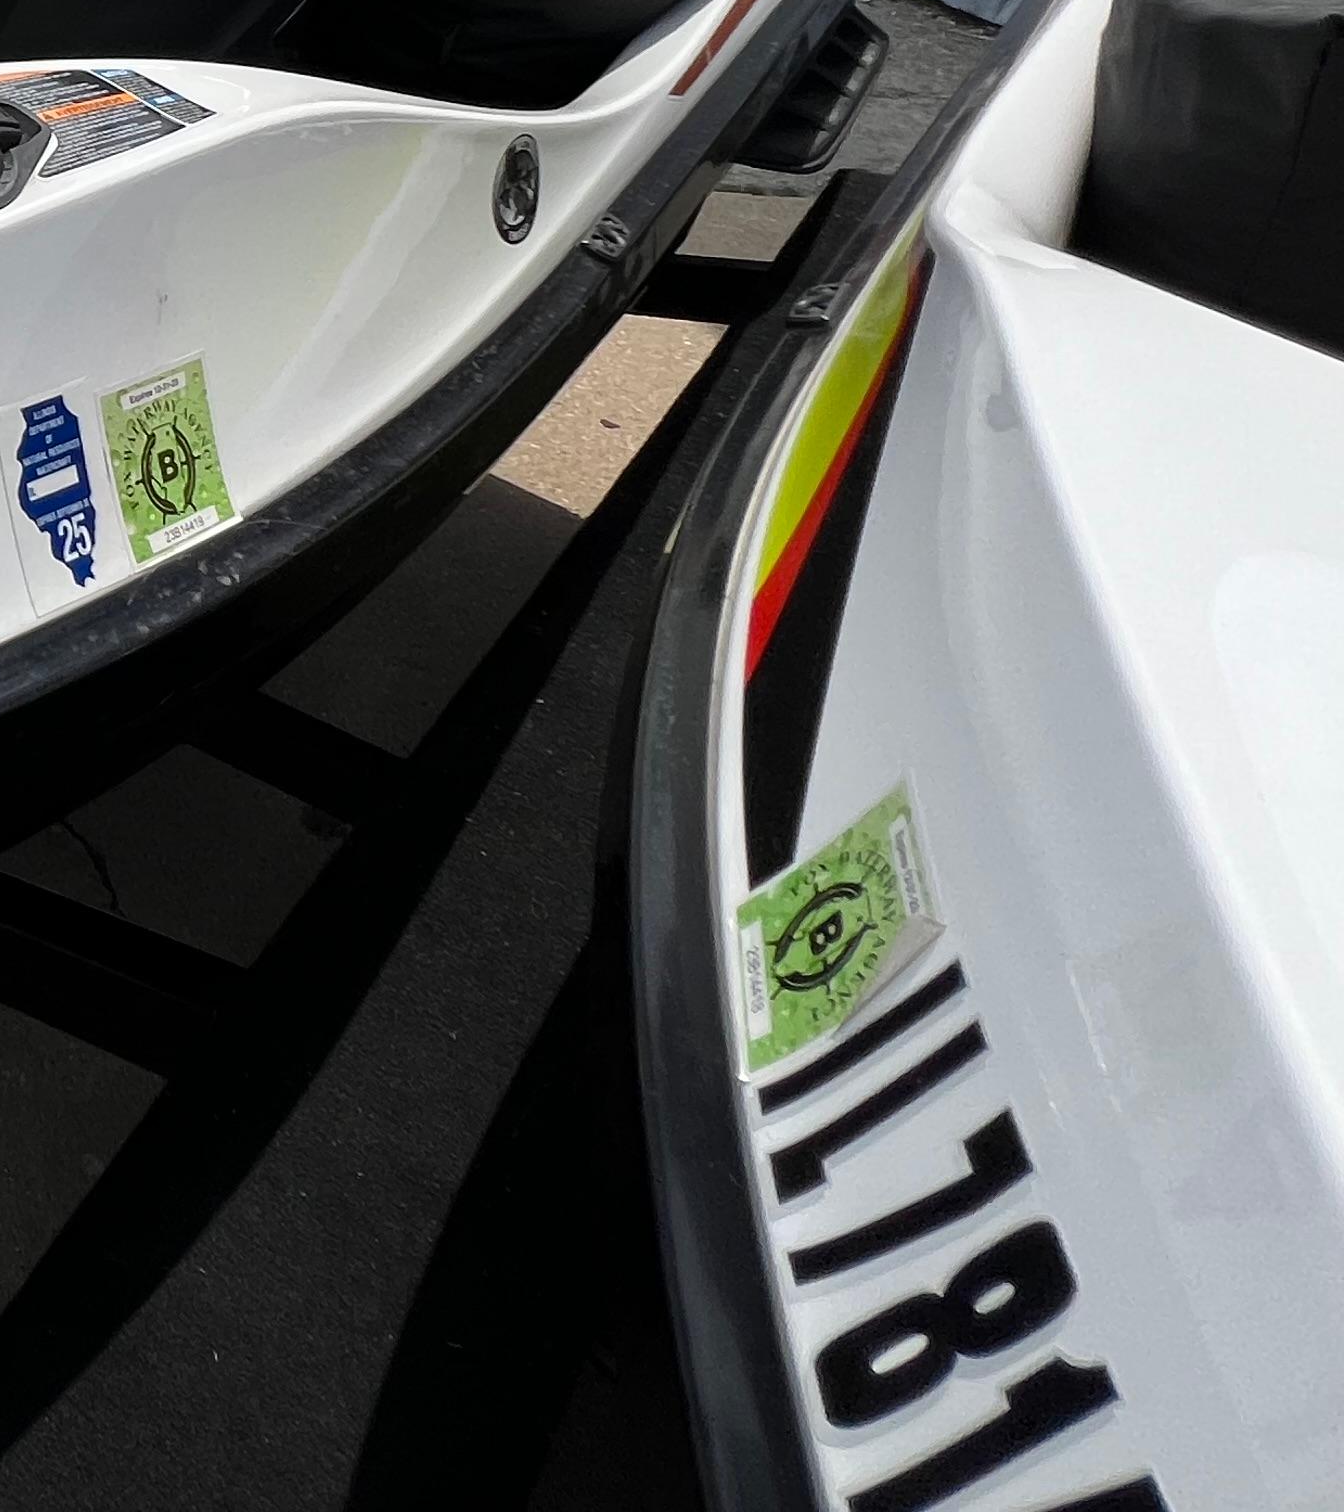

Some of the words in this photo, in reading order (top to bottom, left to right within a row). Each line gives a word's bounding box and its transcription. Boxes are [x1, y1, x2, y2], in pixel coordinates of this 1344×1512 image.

[156, 448, 179, 484] B
[57, 512, 92, 562] 25
[808, 909, 844, 956] B
